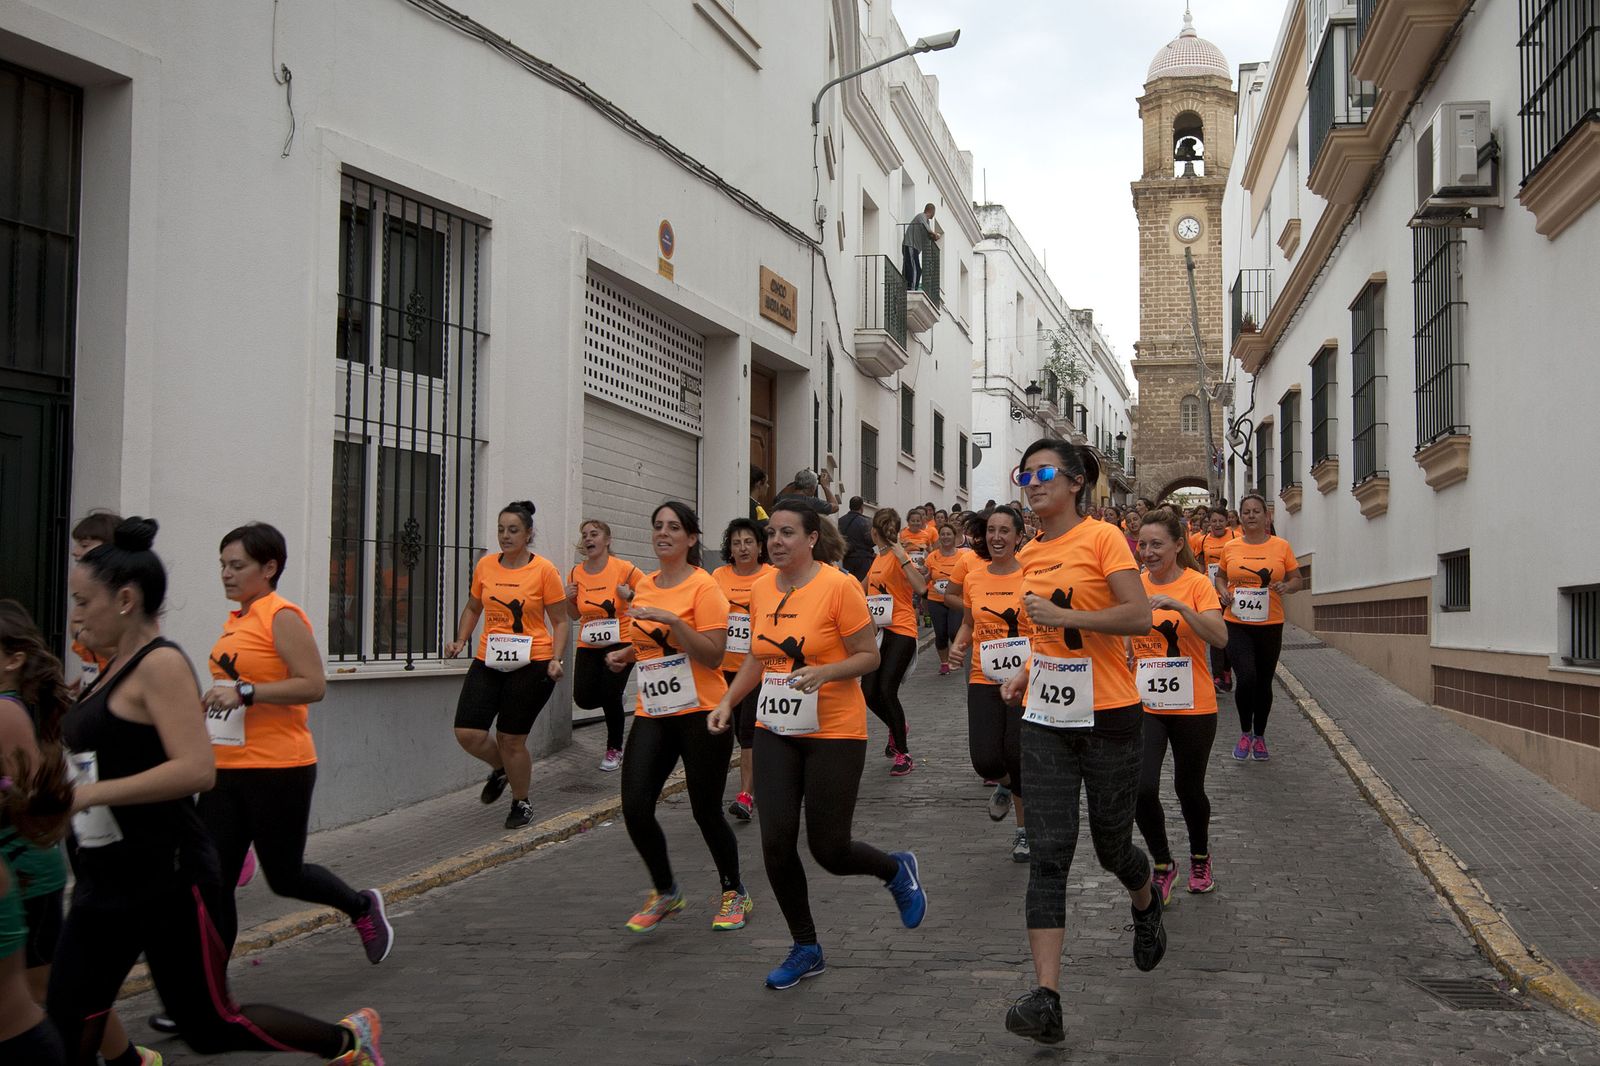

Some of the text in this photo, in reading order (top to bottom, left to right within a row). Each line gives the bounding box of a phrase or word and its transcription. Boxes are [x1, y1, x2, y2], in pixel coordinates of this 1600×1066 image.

[1239, 600, 1262, 610] 944
[590, 632, 612, 642] 310
[728, 626, 750, 640] 615
[988, 640, 1027, 650] INTERSPORT
[496, 650, 518, 662] 211
[644, 658, 686, 671] INTERSPORT
[992, 656, 1022, 670] 140
[1040, 661, 1088, 672] INTERSPORT
[1148, 676, 1180, 693] 136
[1040, 684, 1076, 706] 429
